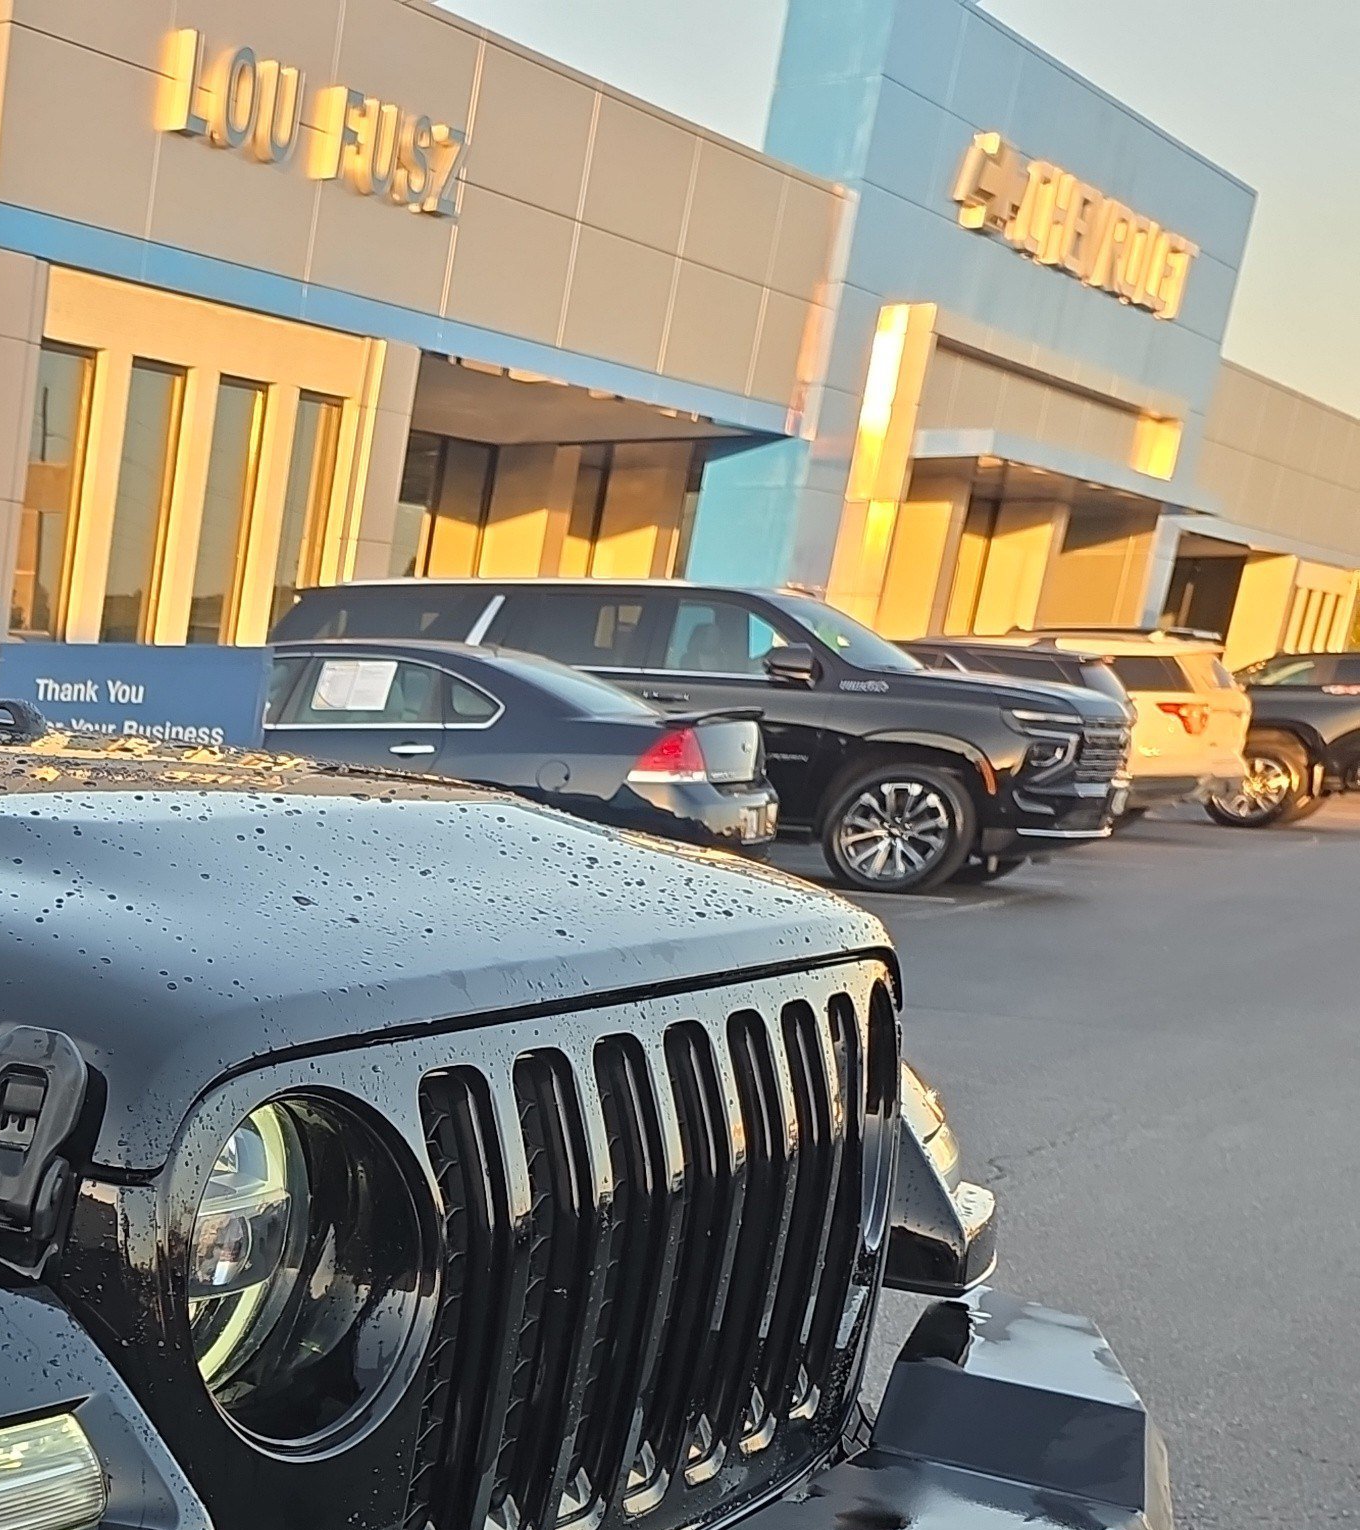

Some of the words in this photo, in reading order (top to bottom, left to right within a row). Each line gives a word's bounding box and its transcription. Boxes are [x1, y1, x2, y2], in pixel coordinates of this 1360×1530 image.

[153, 28, 304, 167] LOU
[306, 86, 466, 217] FUSZ
[35, 677, 99, 703] Thank
[106, 679, 145, 704] You
[122, 719, 225, 746] Business
